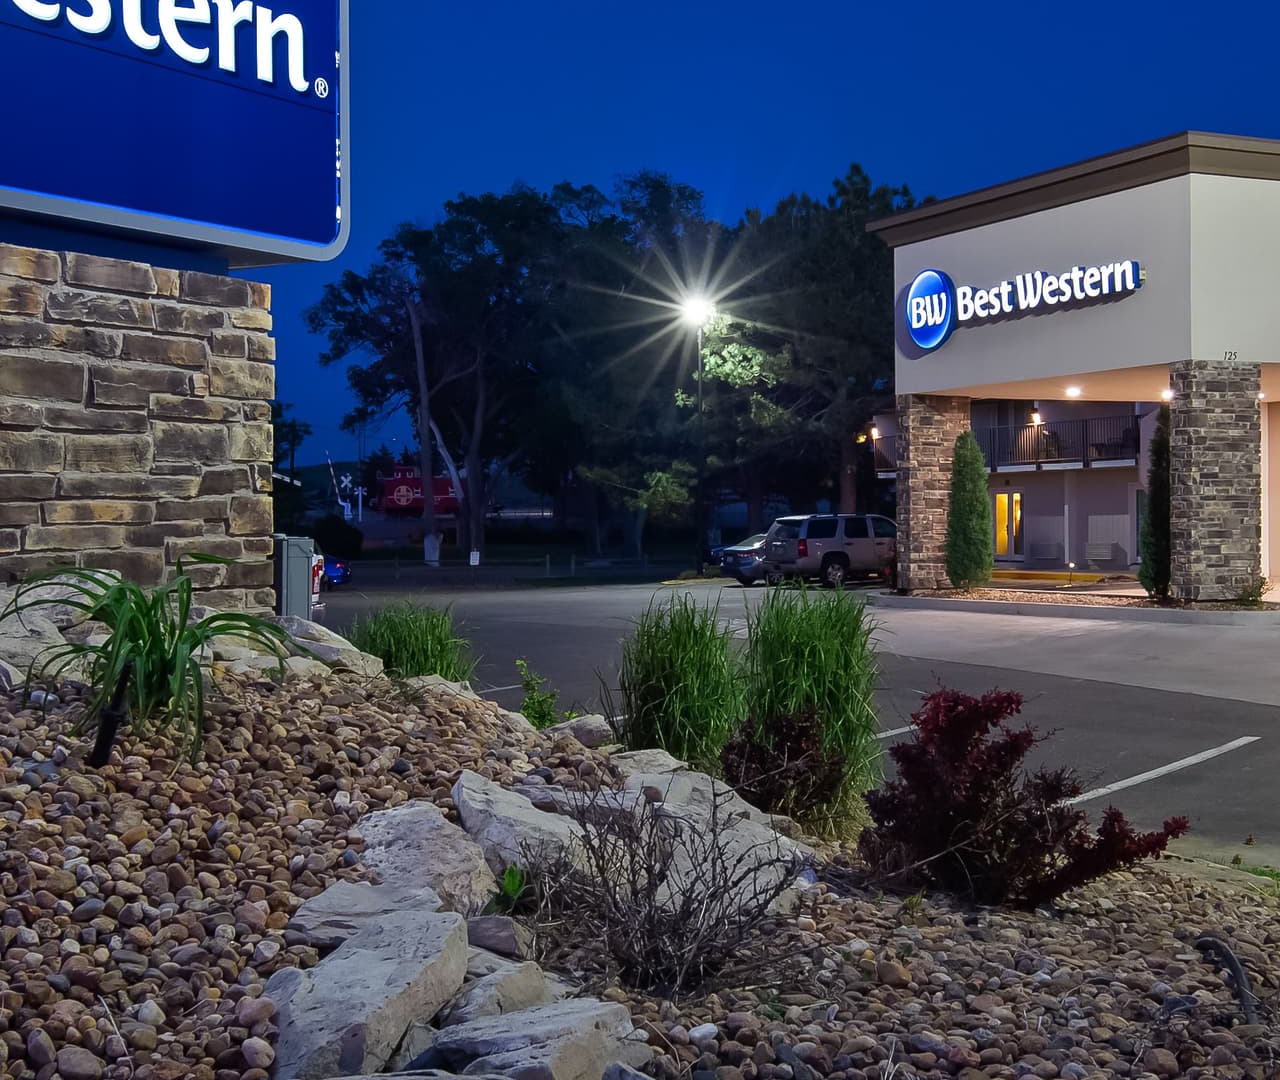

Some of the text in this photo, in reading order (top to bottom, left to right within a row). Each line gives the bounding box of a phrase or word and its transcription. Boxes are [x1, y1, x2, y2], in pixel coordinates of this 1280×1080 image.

[956, 260, 1135, 320] Best Western
[911, 291, 946, 329] BW
[1223, 351, 1238, 361] 125
